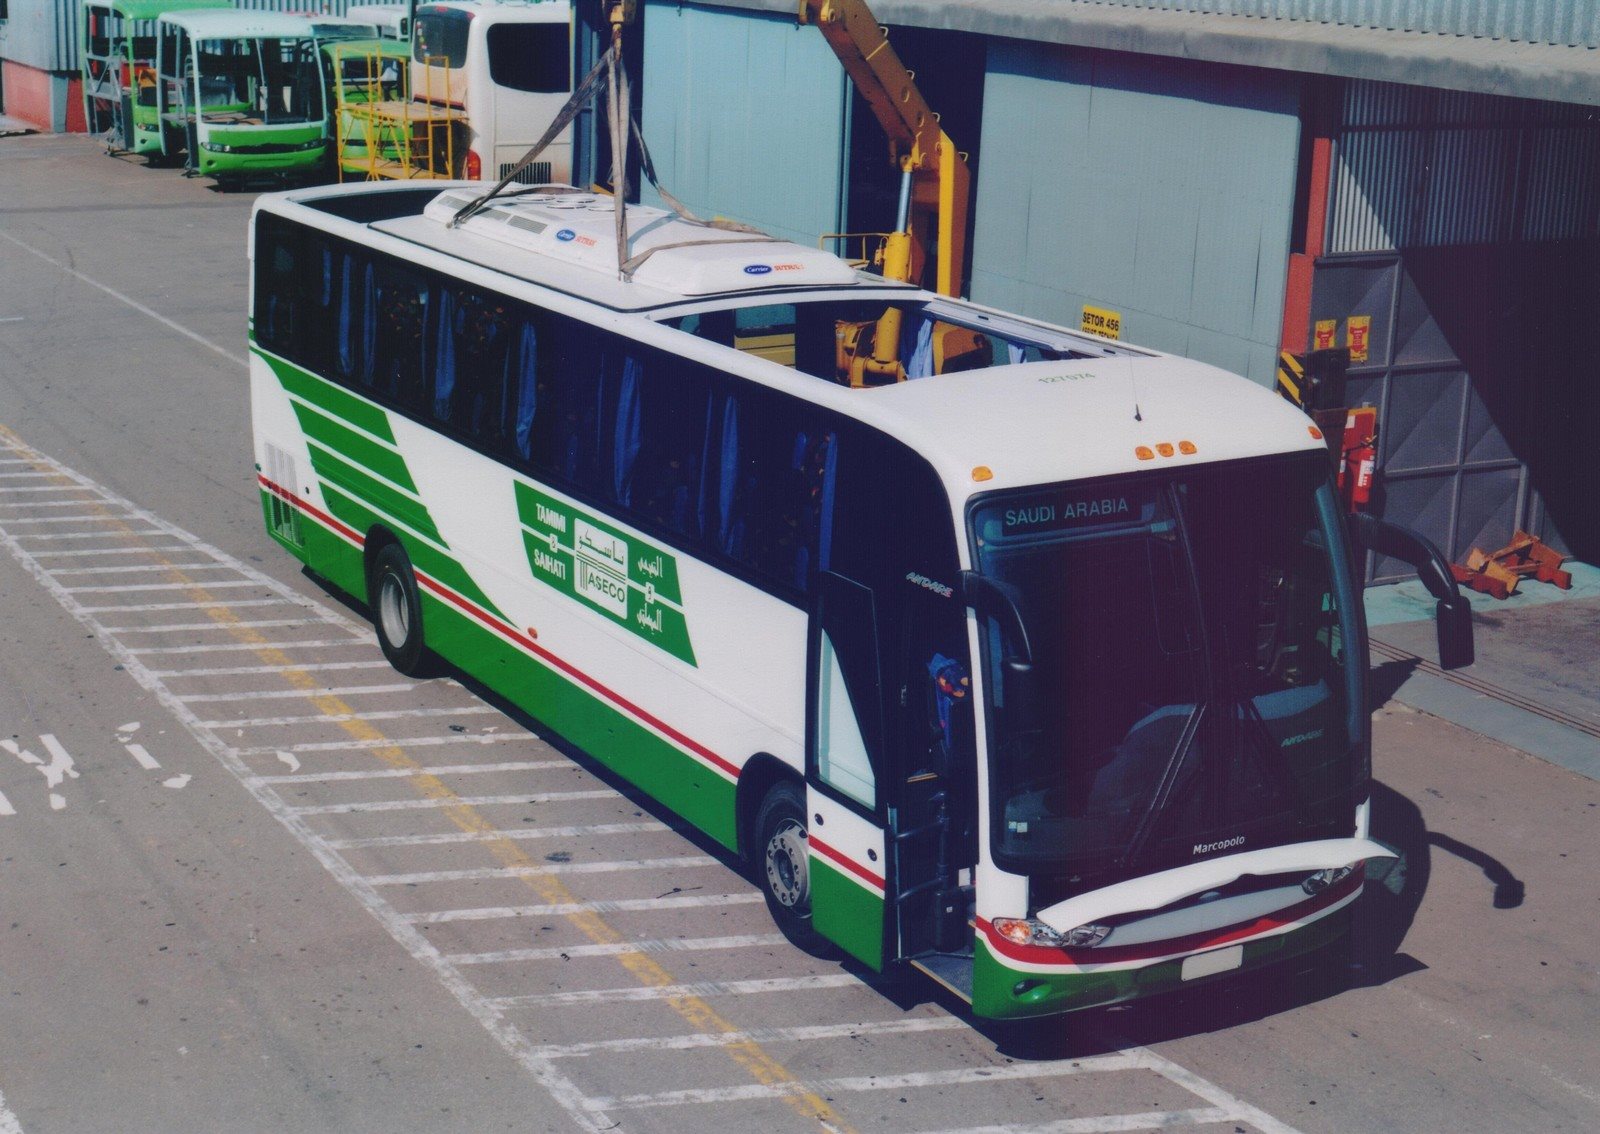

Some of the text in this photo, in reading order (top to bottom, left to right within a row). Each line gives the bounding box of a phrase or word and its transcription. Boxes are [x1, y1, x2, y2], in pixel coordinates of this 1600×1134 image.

[1082, 312, 1119, 332] SETOR 456
[536, 503, 566, 533] TAMIMI
[1005, 498, 1129, 527] SAUDI ARABIA
[1192, 836, 1246, 855] Marcopolo
